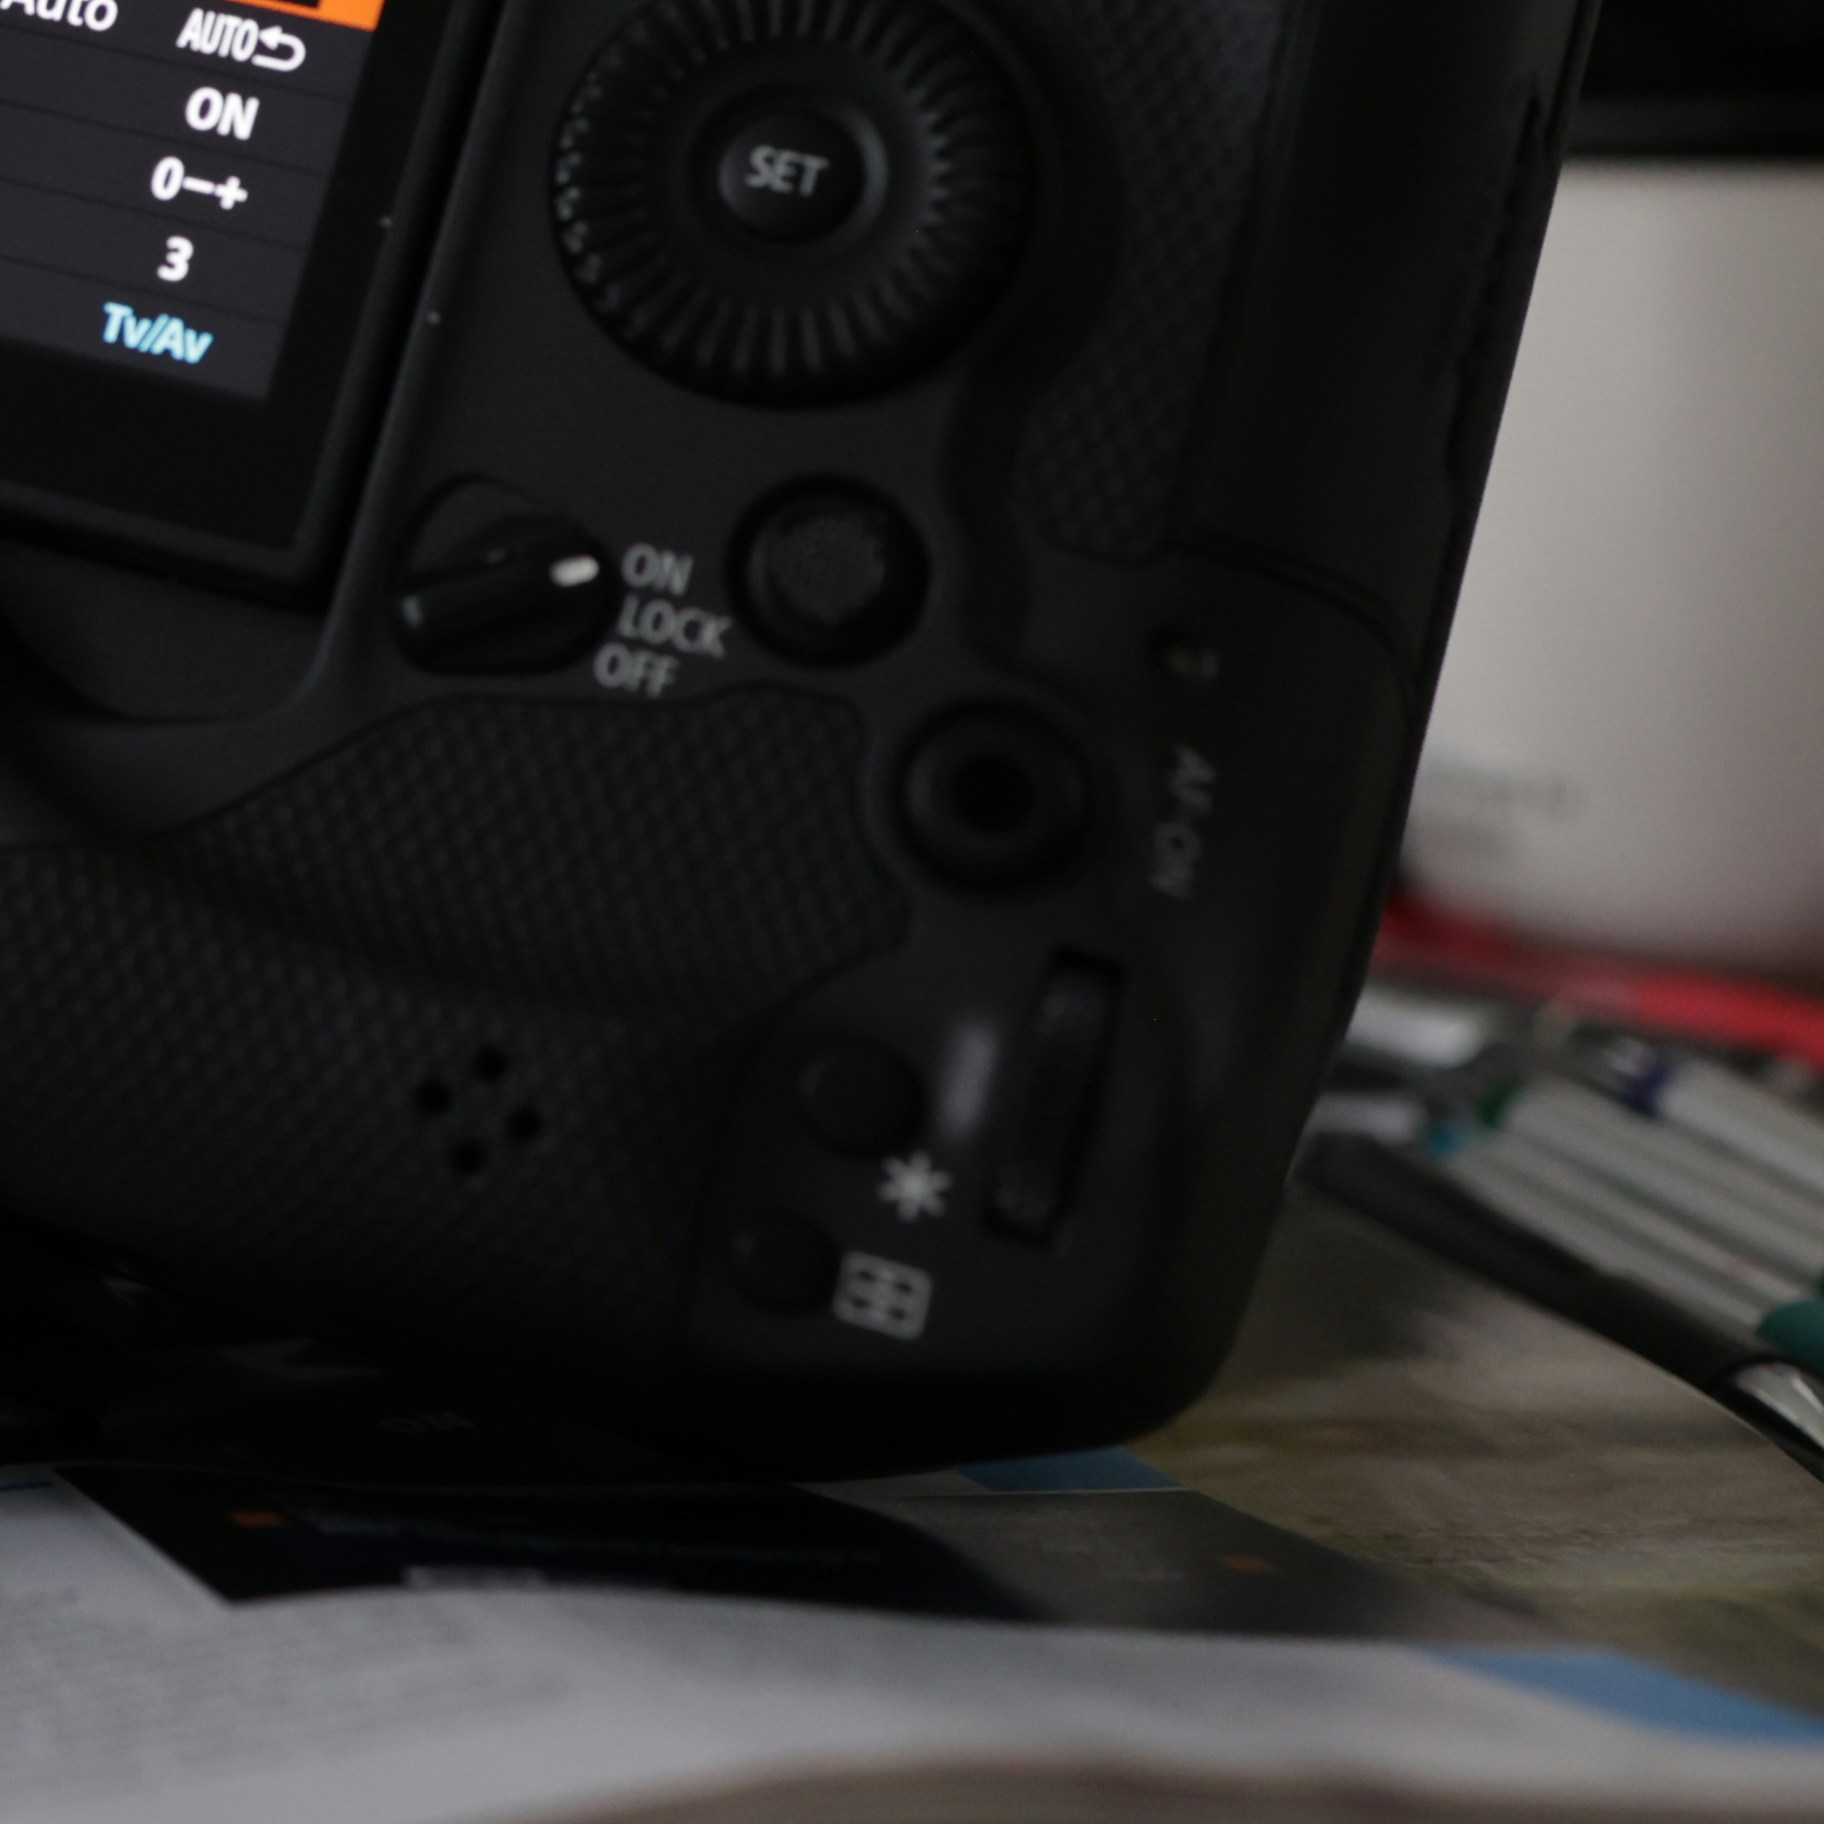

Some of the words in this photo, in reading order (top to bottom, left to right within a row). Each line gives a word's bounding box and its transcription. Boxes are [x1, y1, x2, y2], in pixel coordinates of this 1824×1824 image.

[177, 8, 259, 63] AUTO
[186, 86, 259, 140] ON
[743, 145, 831, 199] SET
[157, 235, 194, 283] 3
[102, 301, 213, 364] Tv/Av
[620, 542, 694, 596] ON
[616, 593, 733, 659] LOCK
[593, 640, 680, 699] OFF
